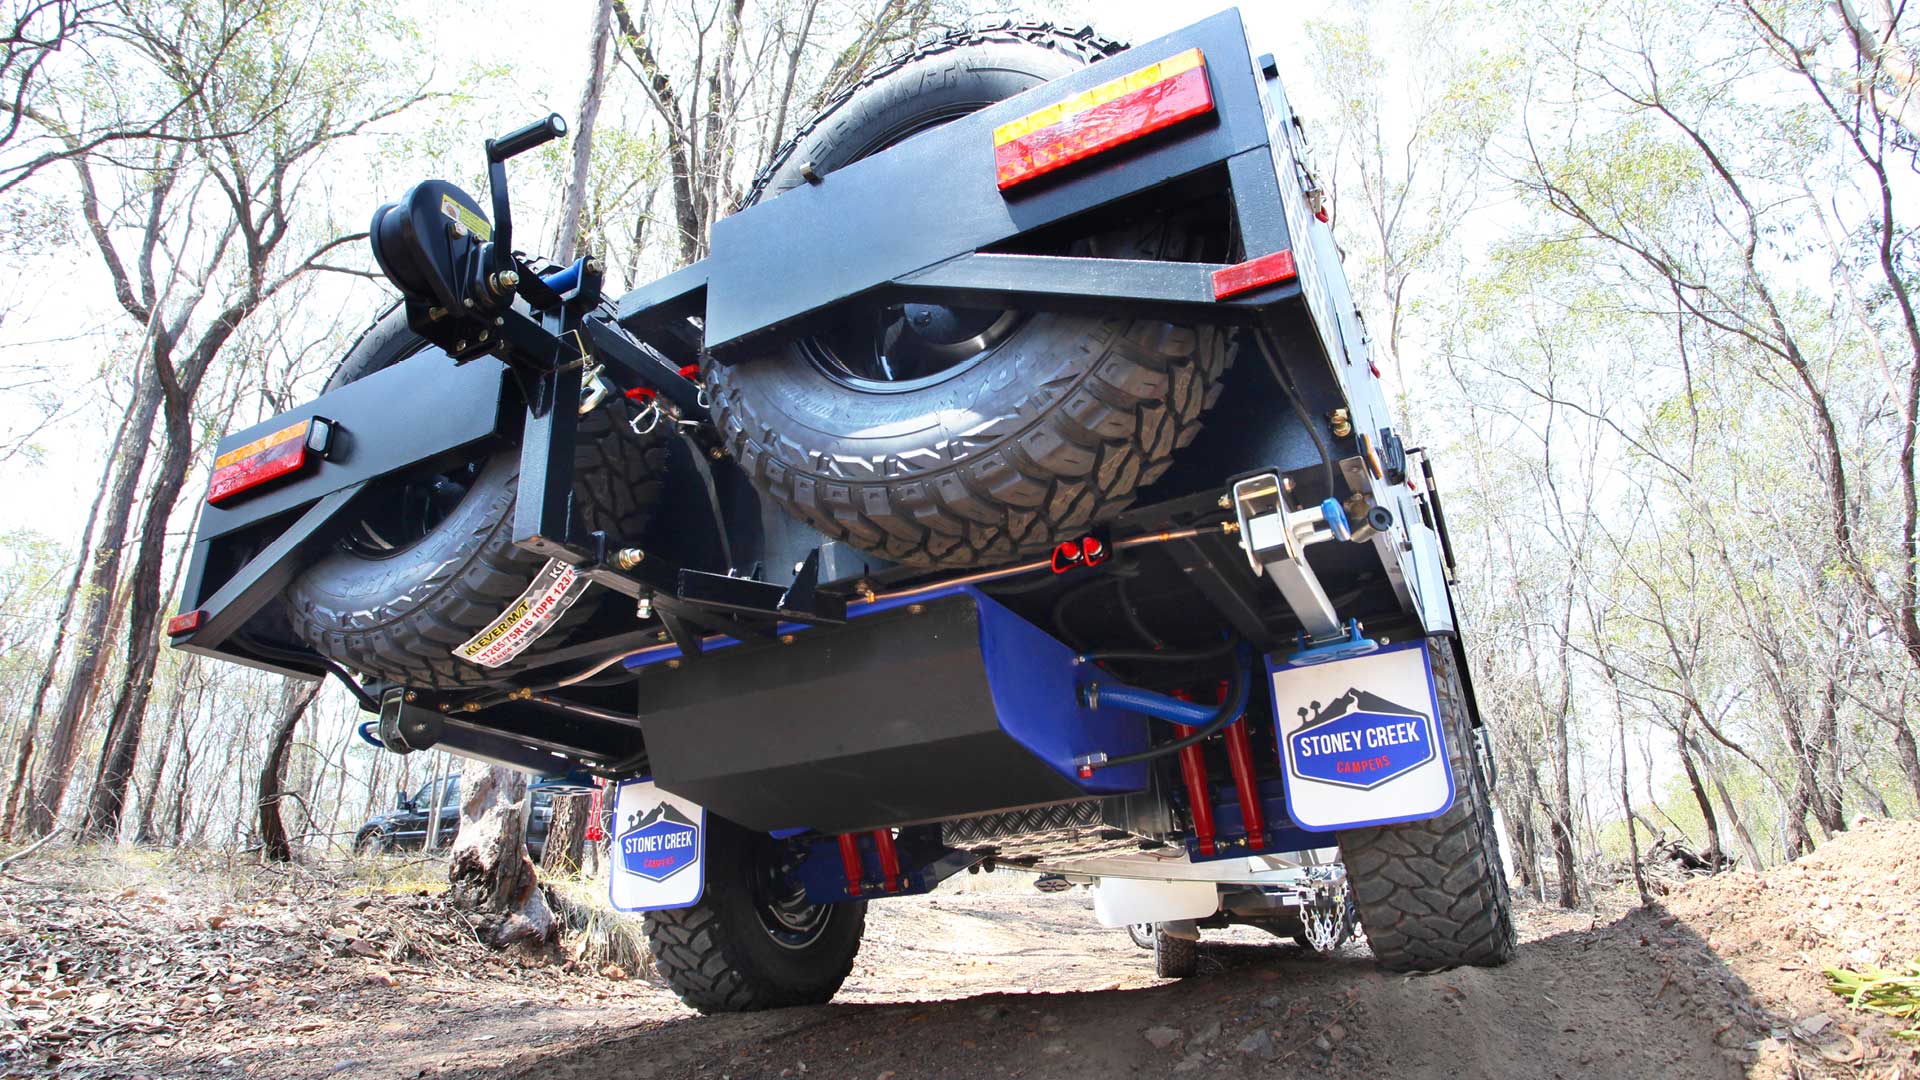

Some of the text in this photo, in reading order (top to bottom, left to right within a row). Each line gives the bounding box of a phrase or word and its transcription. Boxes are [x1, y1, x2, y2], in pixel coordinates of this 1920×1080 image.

[532, 595, 555, 618] 10PR
[464, 622, 508, 656] KLEVER
[507, 601, 528, 624] M/T
[1300, 721, 1420, 757] STONEY CREEK
[1336, 755, 1391, 773] CAMPERS
[625, 831, 692, 854] STONEY CREEK
